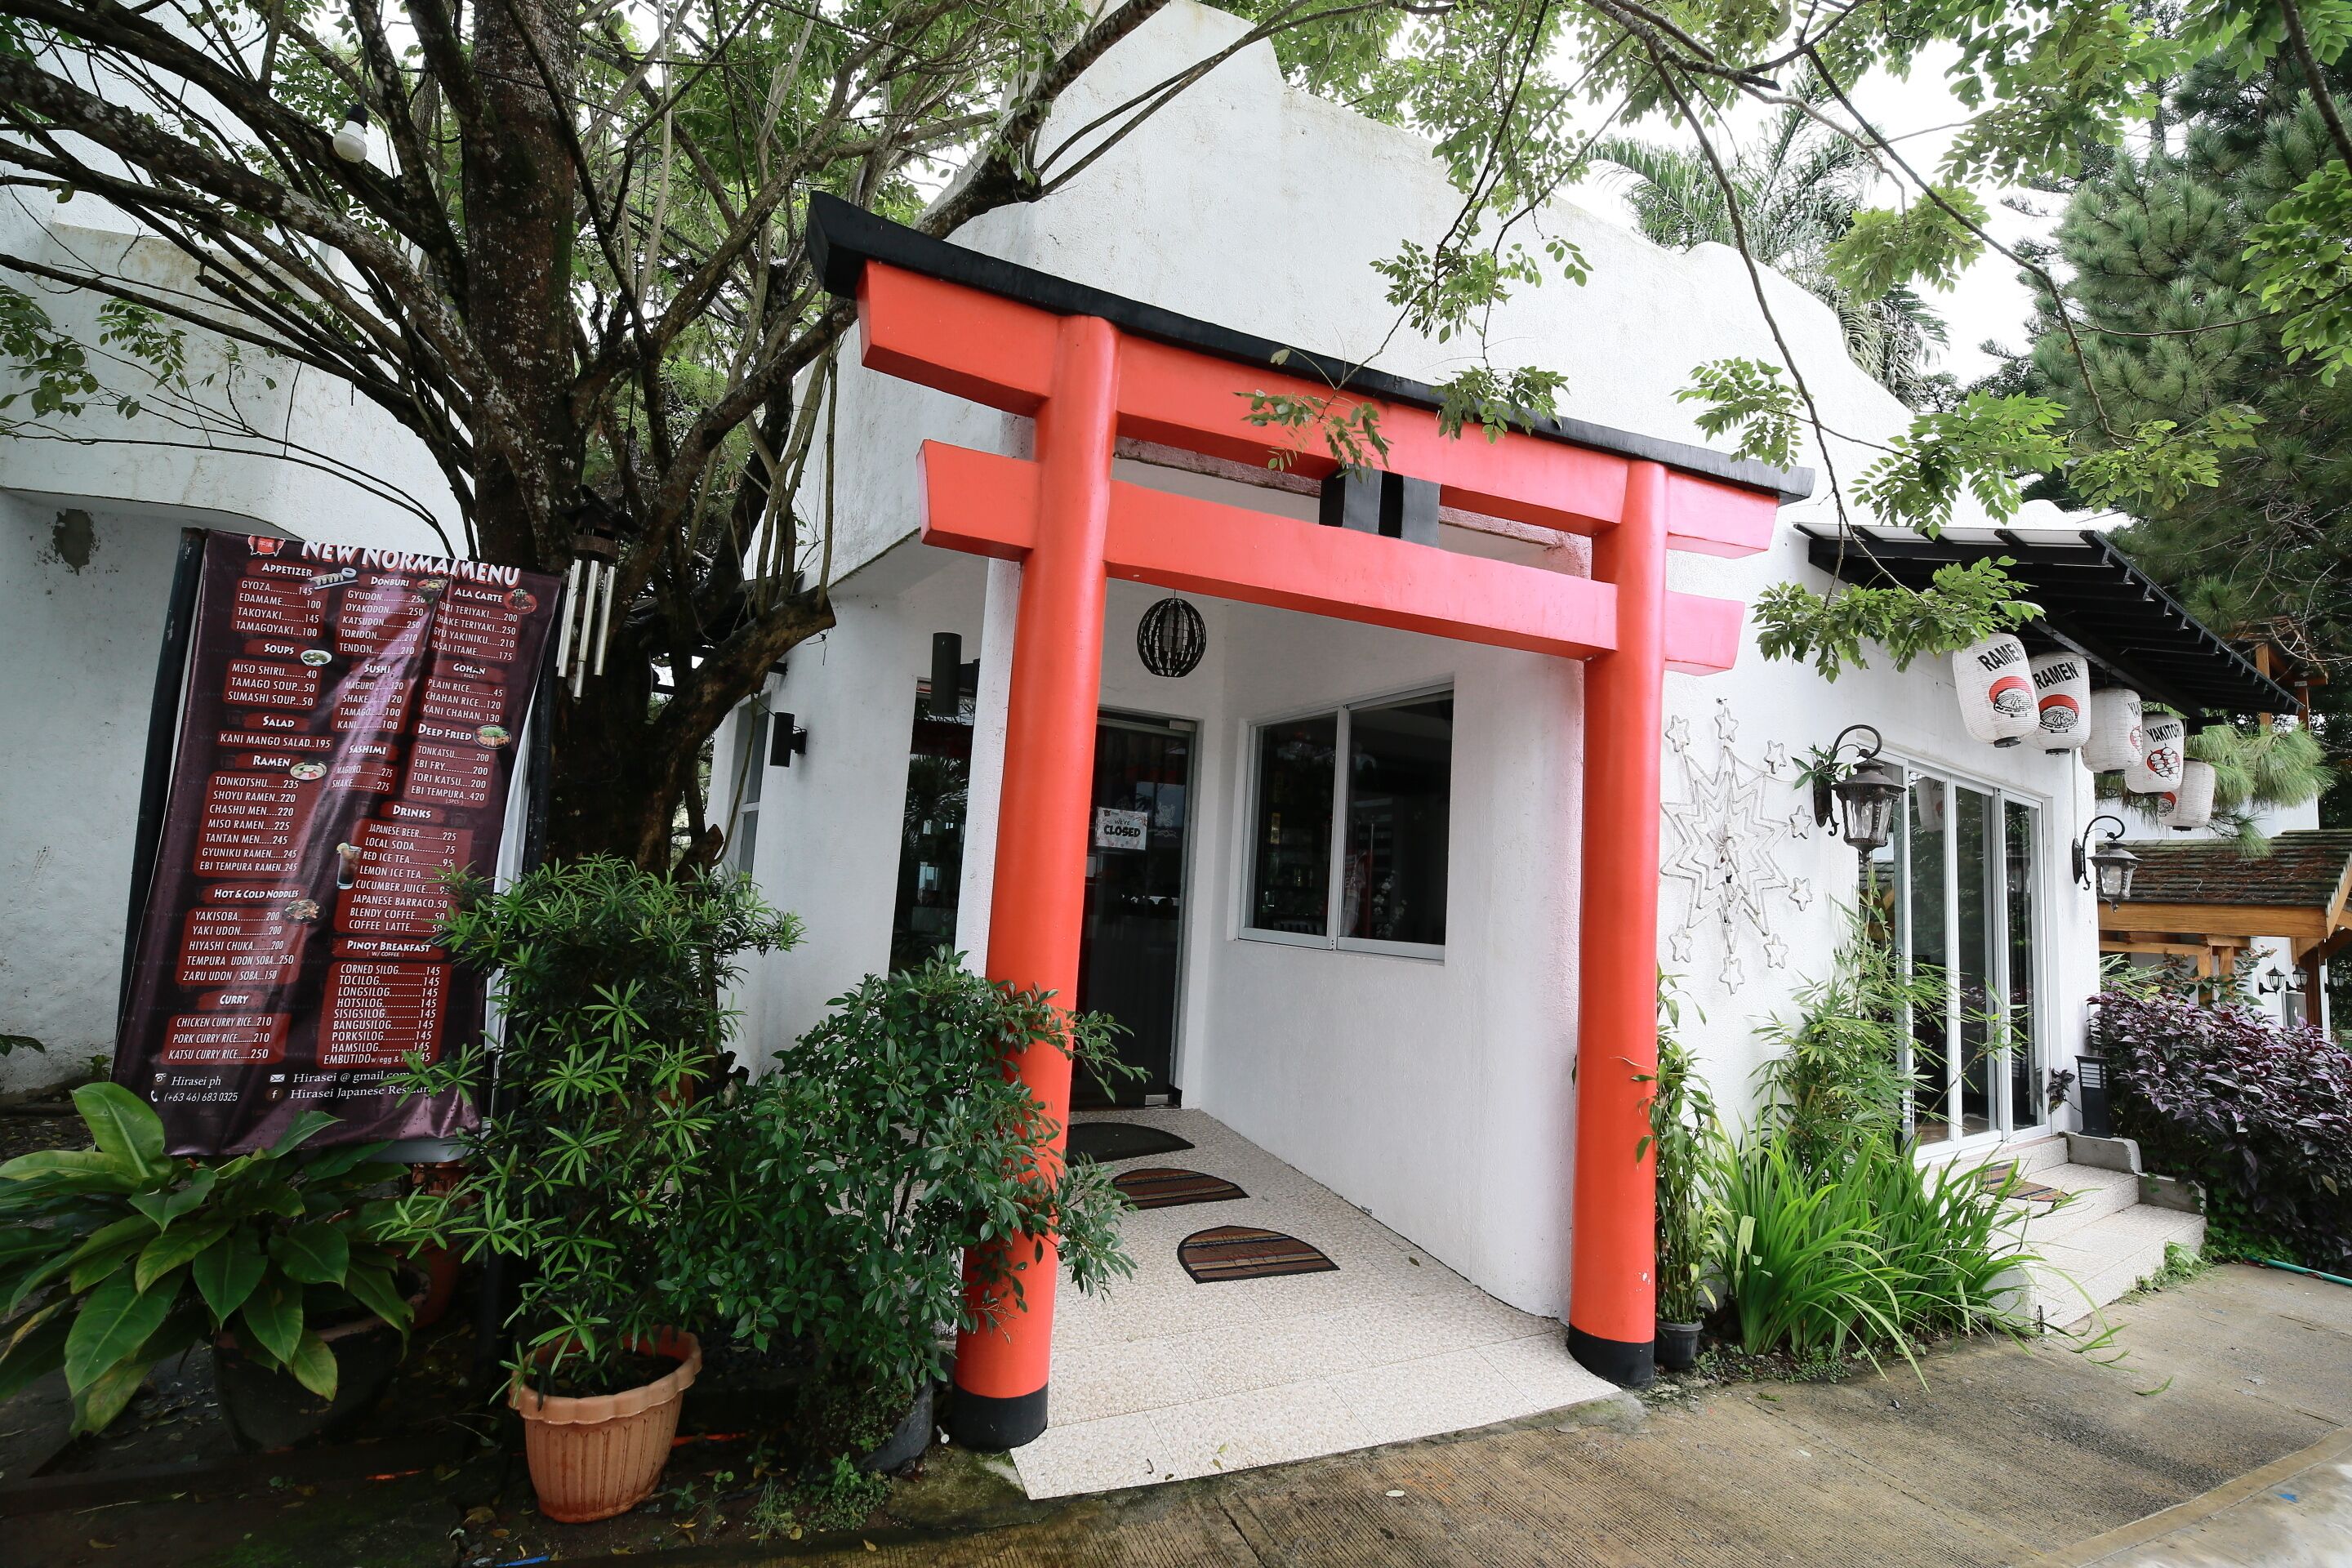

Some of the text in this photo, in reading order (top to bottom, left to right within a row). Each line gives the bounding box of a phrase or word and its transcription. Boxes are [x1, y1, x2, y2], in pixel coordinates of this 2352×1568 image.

[301, 541, 357, 564] NEW
[453, 560, 520, 586] MENU
[261, 563, 312, 577] APPETIZER
[242, 580, 270, 591] GYOZA
[371, 577, 409, 587] DONBURI
[239, 593, 321, 609] EDAMAME 100
[348, 590, 382, 601] GYUDON
[474, 590, 502, 603] CARTE
[345, 604, 390, 613] OYAKODON
[439, 601, 489, 618] TORI TERIYAKI
[238, 607, 319, 623] TAKOYAKI 145
[342, 616, 384, 626] KATSUDON
[436, 614, 495, 632] SHAKE TERIYAKI
[236, 621, 318, 637] TAMAGOYAKI 100
[341, 629, 377, 639] TORIDON
[434, 626, 488, 644] GYU YAKINIKU
[264, 643, 295, 655] SOUPS
[340, 643, 372, 653] TENDON
[432, 639, 478, 656] YASAI ITAME
[1977, 640, 2025, 671] RAMEN
[232, 663, 285, 676] MISO SHIRU
[364, 664, 391, 674] SUSHI
[2034, 662, 2079, 690] RAMEN
[231, 677, 298, 691] TAMAGO SOUP
[345, 682, 375, 690] MAGURO
[428, 679, 470, 693] PLAIN RICE
[228, 691, 296, 705] SUMASHI SOUP
[342, 694, 368, 703] SHAKE
[425, 692, 479, 707] CHAHAN RICE
[340, 707, 371, 716] TAMAGO
[423, 705, 480, 721] KANI CHAHAN
[263, 715, 295, 728] SALAD
[337, 720, 357, 729] KANI
[418, 723, 472, 741] DEEP FRIED
[220, 733, 310, 747] KANI MANGO SALAD
[349, 745, 386, 755] SASHIMI
[418, 746, 455, 758] TONKATSU
[252, 755, 291, 767] RAMEN
[414, 759, 446, 771] EBI FRY
[336, 765, 361, 774] MAGURO
[215, 776, 299, 789] TONKOTSHU 235
[332, 778, 353, 788] SHAKE
[413, 772, 461, 786] TORI KATSU
[212, 790, 275, 802] SHOYU RAMEN
[411, 785, 464, 800] EBI TEMPURA
[209, 804, 267, 815] CHASHU MEN
[393, 805, 431, 818] DRINKS
[207, 819, 264, 830] MISO RAMEN
[368, 824, 420, 838] JAPANESE BEER
[1104, 825, 1141, 837] CLOSED
[206, 833, 261, 844] TANTAN MEN
[365, 837, 414, 851] LOCAL SODA
[202, 847, 272, 858] GYUNIKU RAMEN
[363, 851, 410, 864] RED ICE TEA
[199, 862, 281, 871] EBI TEMPURA RAMEN
[359, 866, 421, 879] LEMON ICE TEA
[355, 880, 426, 893] CUCUMBER JUICE
[214, 889, 234, 898] HOT
[235, 889, 242, 898] &
[243, 889, 265, 898] COLD
[352, 894, 393, 905] JAPANESE
[195, 911, 238, 921] YAKISOBA
[350, 908, 416, 920] BLENDY COFFEE
[193, 926, 241, 936] YAKI UDON
[349, 920, 410, 932] COFFEE LATTE
[189, 942, 253, 951] HIYASHI CHUKA
[346, 940, 431, 952] PINOY BREAKFAST
[187, 956, 225, 965] TEMPURA
[341, 964, 440, 975] CORNED SILOG 145
[183, 971, 258, 981] ZARU UDON SOBA
[339, 975, 380, 985] TOCILOG
[338, 987, 438, 997] LONGSILOG 145
[220, 994, 249, 1004] CURRY
[336, 998, 383, 1008] HOTSILOG
[334, 1009, 385, 1018] SISIGSILOG
[176, 1017, 252, 1027] CHICKEN CURRY RICE
[333, 1020, 391, 1030] BANGUSILOG
[172, 1034, 238, 1044] PORK CURRY RICE
[332, 1031, 384, 1041] PORKSILOG
[332, 1043, 379, 1052] HAMSILOG
[168, 1049, 238, 1060] KATSU CURRY RICE
[171, 1076, 221, 1089] Hirasei ph
[293, 1073, 350, 1083] Hirasei @
[164, 1092, 238, 1102] (+63 46) 683 0325
[290, 1086, 385, 1099] Hirasei Japanese
